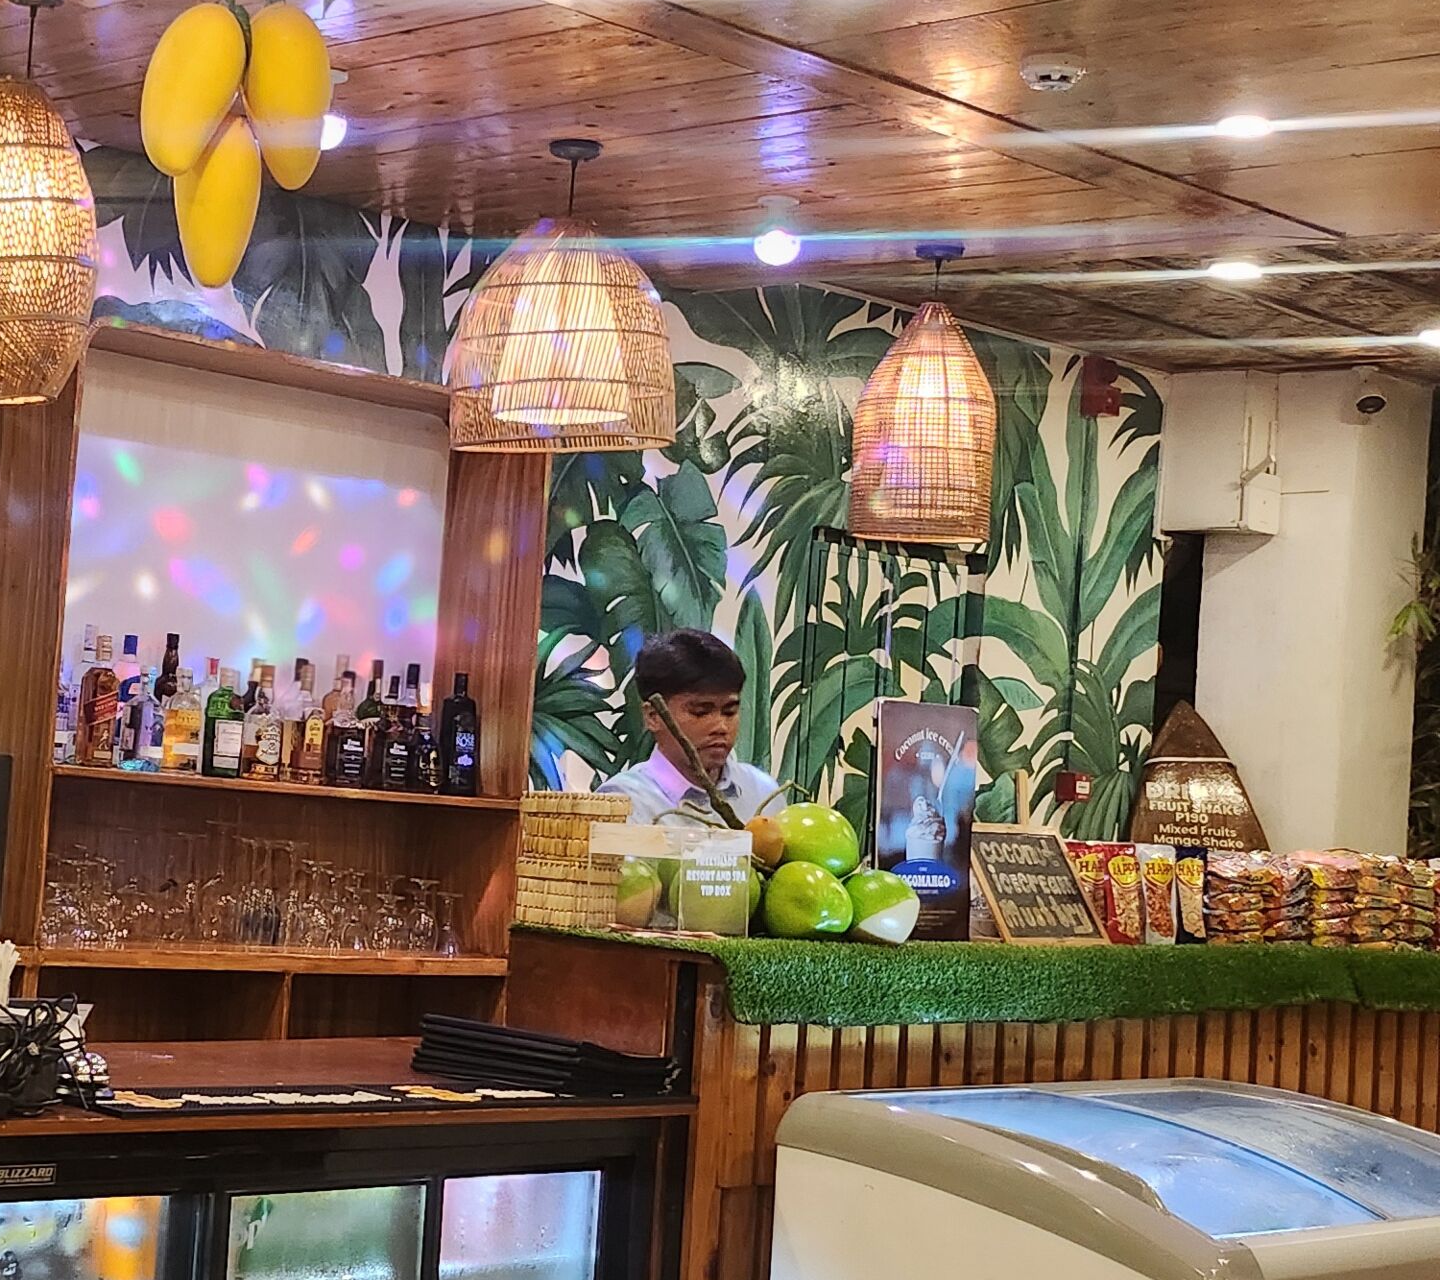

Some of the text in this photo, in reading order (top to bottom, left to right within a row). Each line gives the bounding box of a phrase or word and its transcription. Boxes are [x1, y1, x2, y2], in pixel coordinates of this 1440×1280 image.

[894, 730, 925, 761] Coconut
[926, 727, 939, 742] ice
[1145, 780, 1244, 805] DRIS
[1149, 800, 1191, 813] FRUIT
[1175, 811, 1209, 824] P190
[1159, 823, 1238, 838] Mixed Fruits
[1153, 834, 1245, 849] Mango Shake
[898, 874, 951, 888] OCOMANGO
[700, 884, 731, 897] TIP BOX
